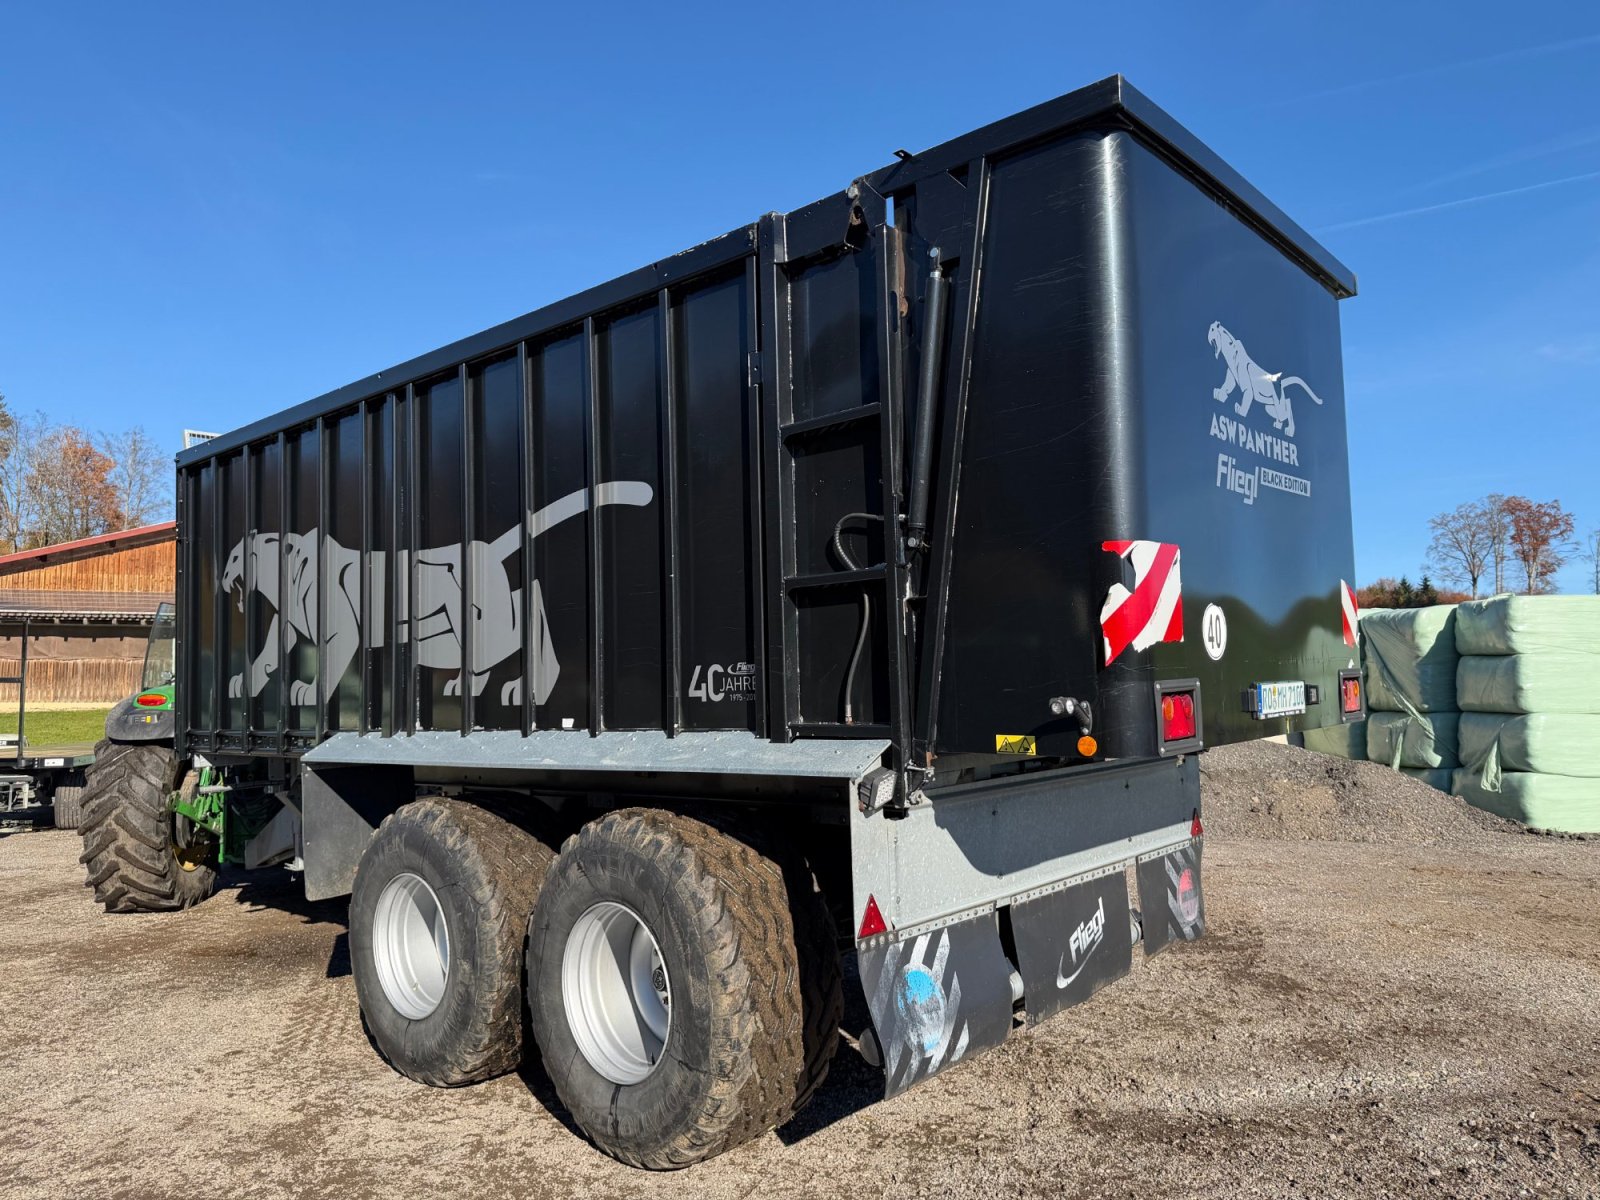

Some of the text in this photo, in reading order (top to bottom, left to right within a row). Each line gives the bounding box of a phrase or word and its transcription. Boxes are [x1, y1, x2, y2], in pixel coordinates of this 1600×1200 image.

[1210, 412, 1299, 467] ASW PANTHER
[1216, 453, 1259, 505] Fliegl
[1262, 468, 1309, 495] BLACK EDITION
[1208, 614, 1221, 650] 40
[1069, 896, 1106, 966] Fliegl
